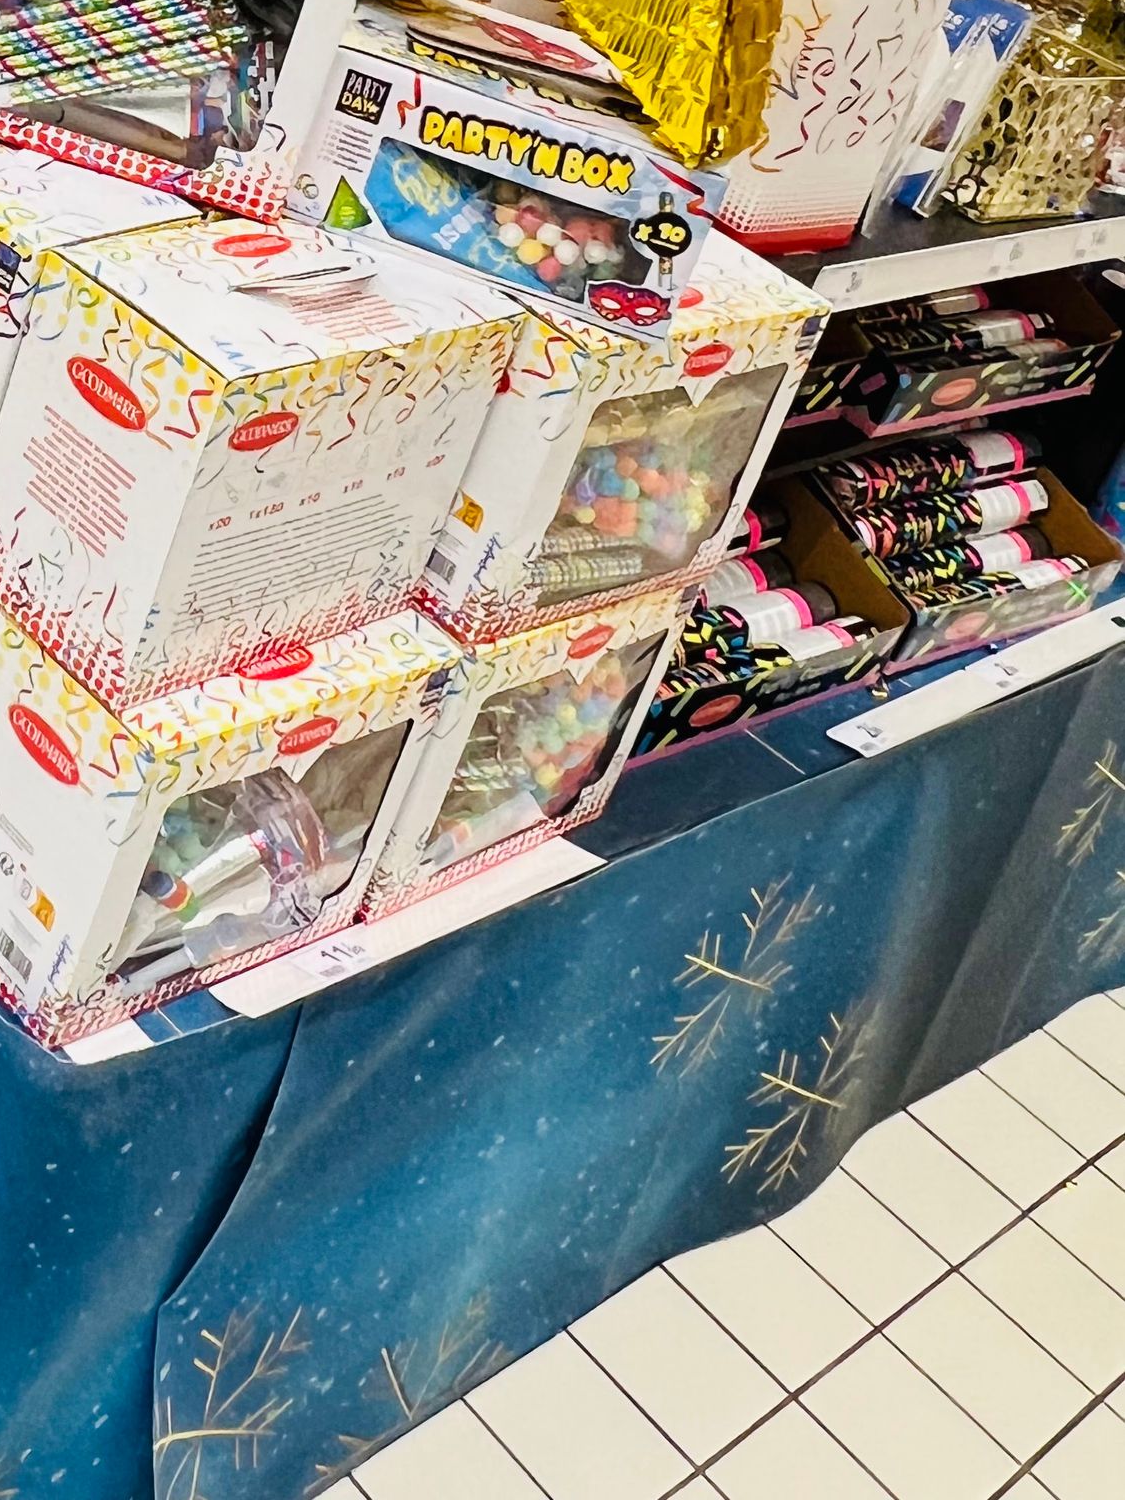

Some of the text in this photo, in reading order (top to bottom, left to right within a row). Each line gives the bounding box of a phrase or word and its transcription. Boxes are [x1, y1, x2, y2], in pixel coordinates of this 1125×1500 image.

[341, 91, 371, 113] DAY
[346, 73, 387, 102] PARTY
[420, 106, 560, 178] PARTY'N
[561, 145, 635, 195] BOX
[658, 222, 686, 244] 10
[71, 361, 141, 426] GOODMARK
[10, 711, 77, 781] GOODMARK
